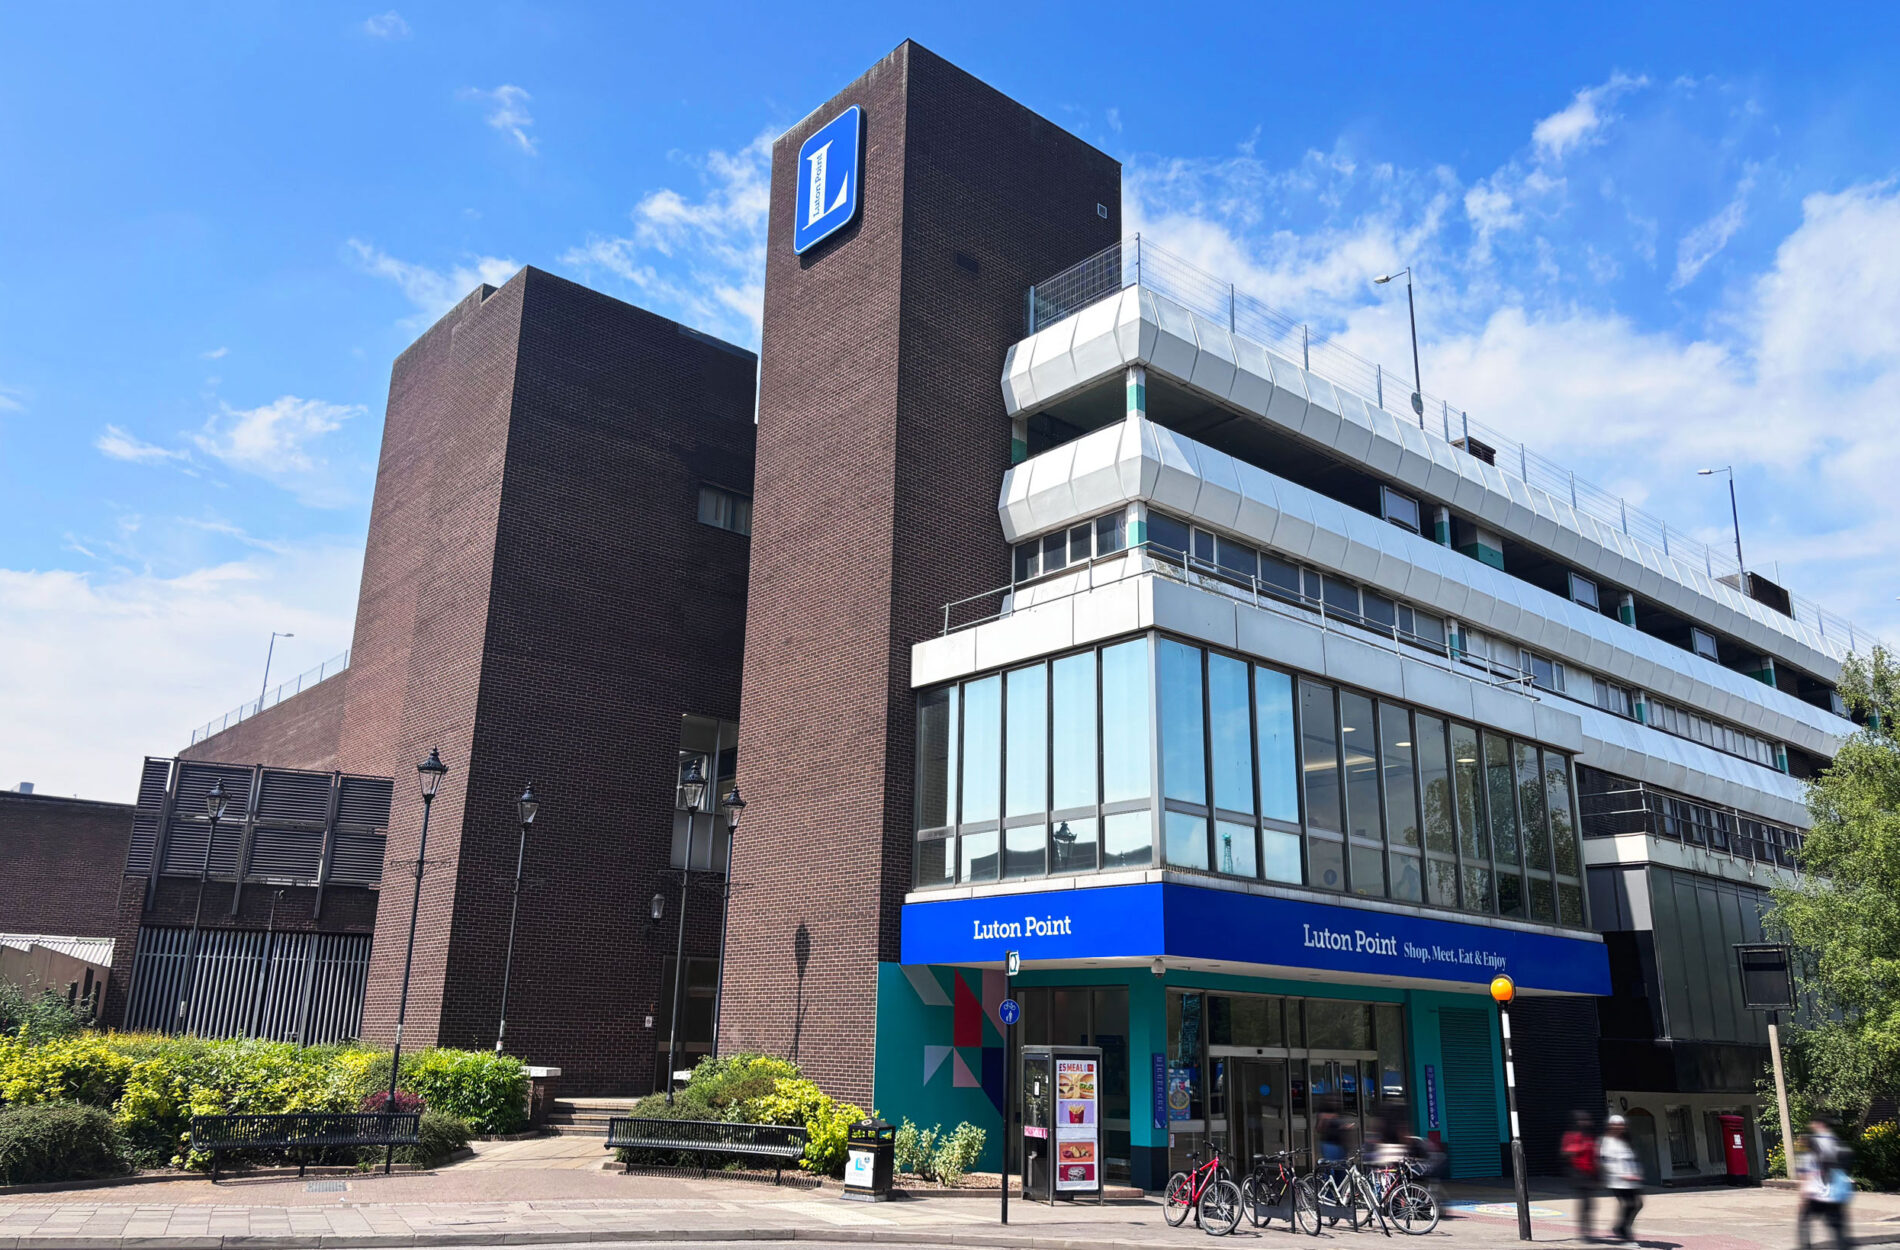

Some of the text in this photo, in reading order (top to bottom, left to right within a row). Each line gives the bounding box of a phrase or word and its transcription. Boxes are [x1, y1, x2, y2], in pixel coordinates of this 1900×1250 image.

[802, 139, 848, 231] L
[813, 153, 823, 218] Luton Point
[973, 915, 1072, 940] Luton Point
[1303, 923, 1507, 971] Luton Point Shop, Meet, Eat & Enjoy
